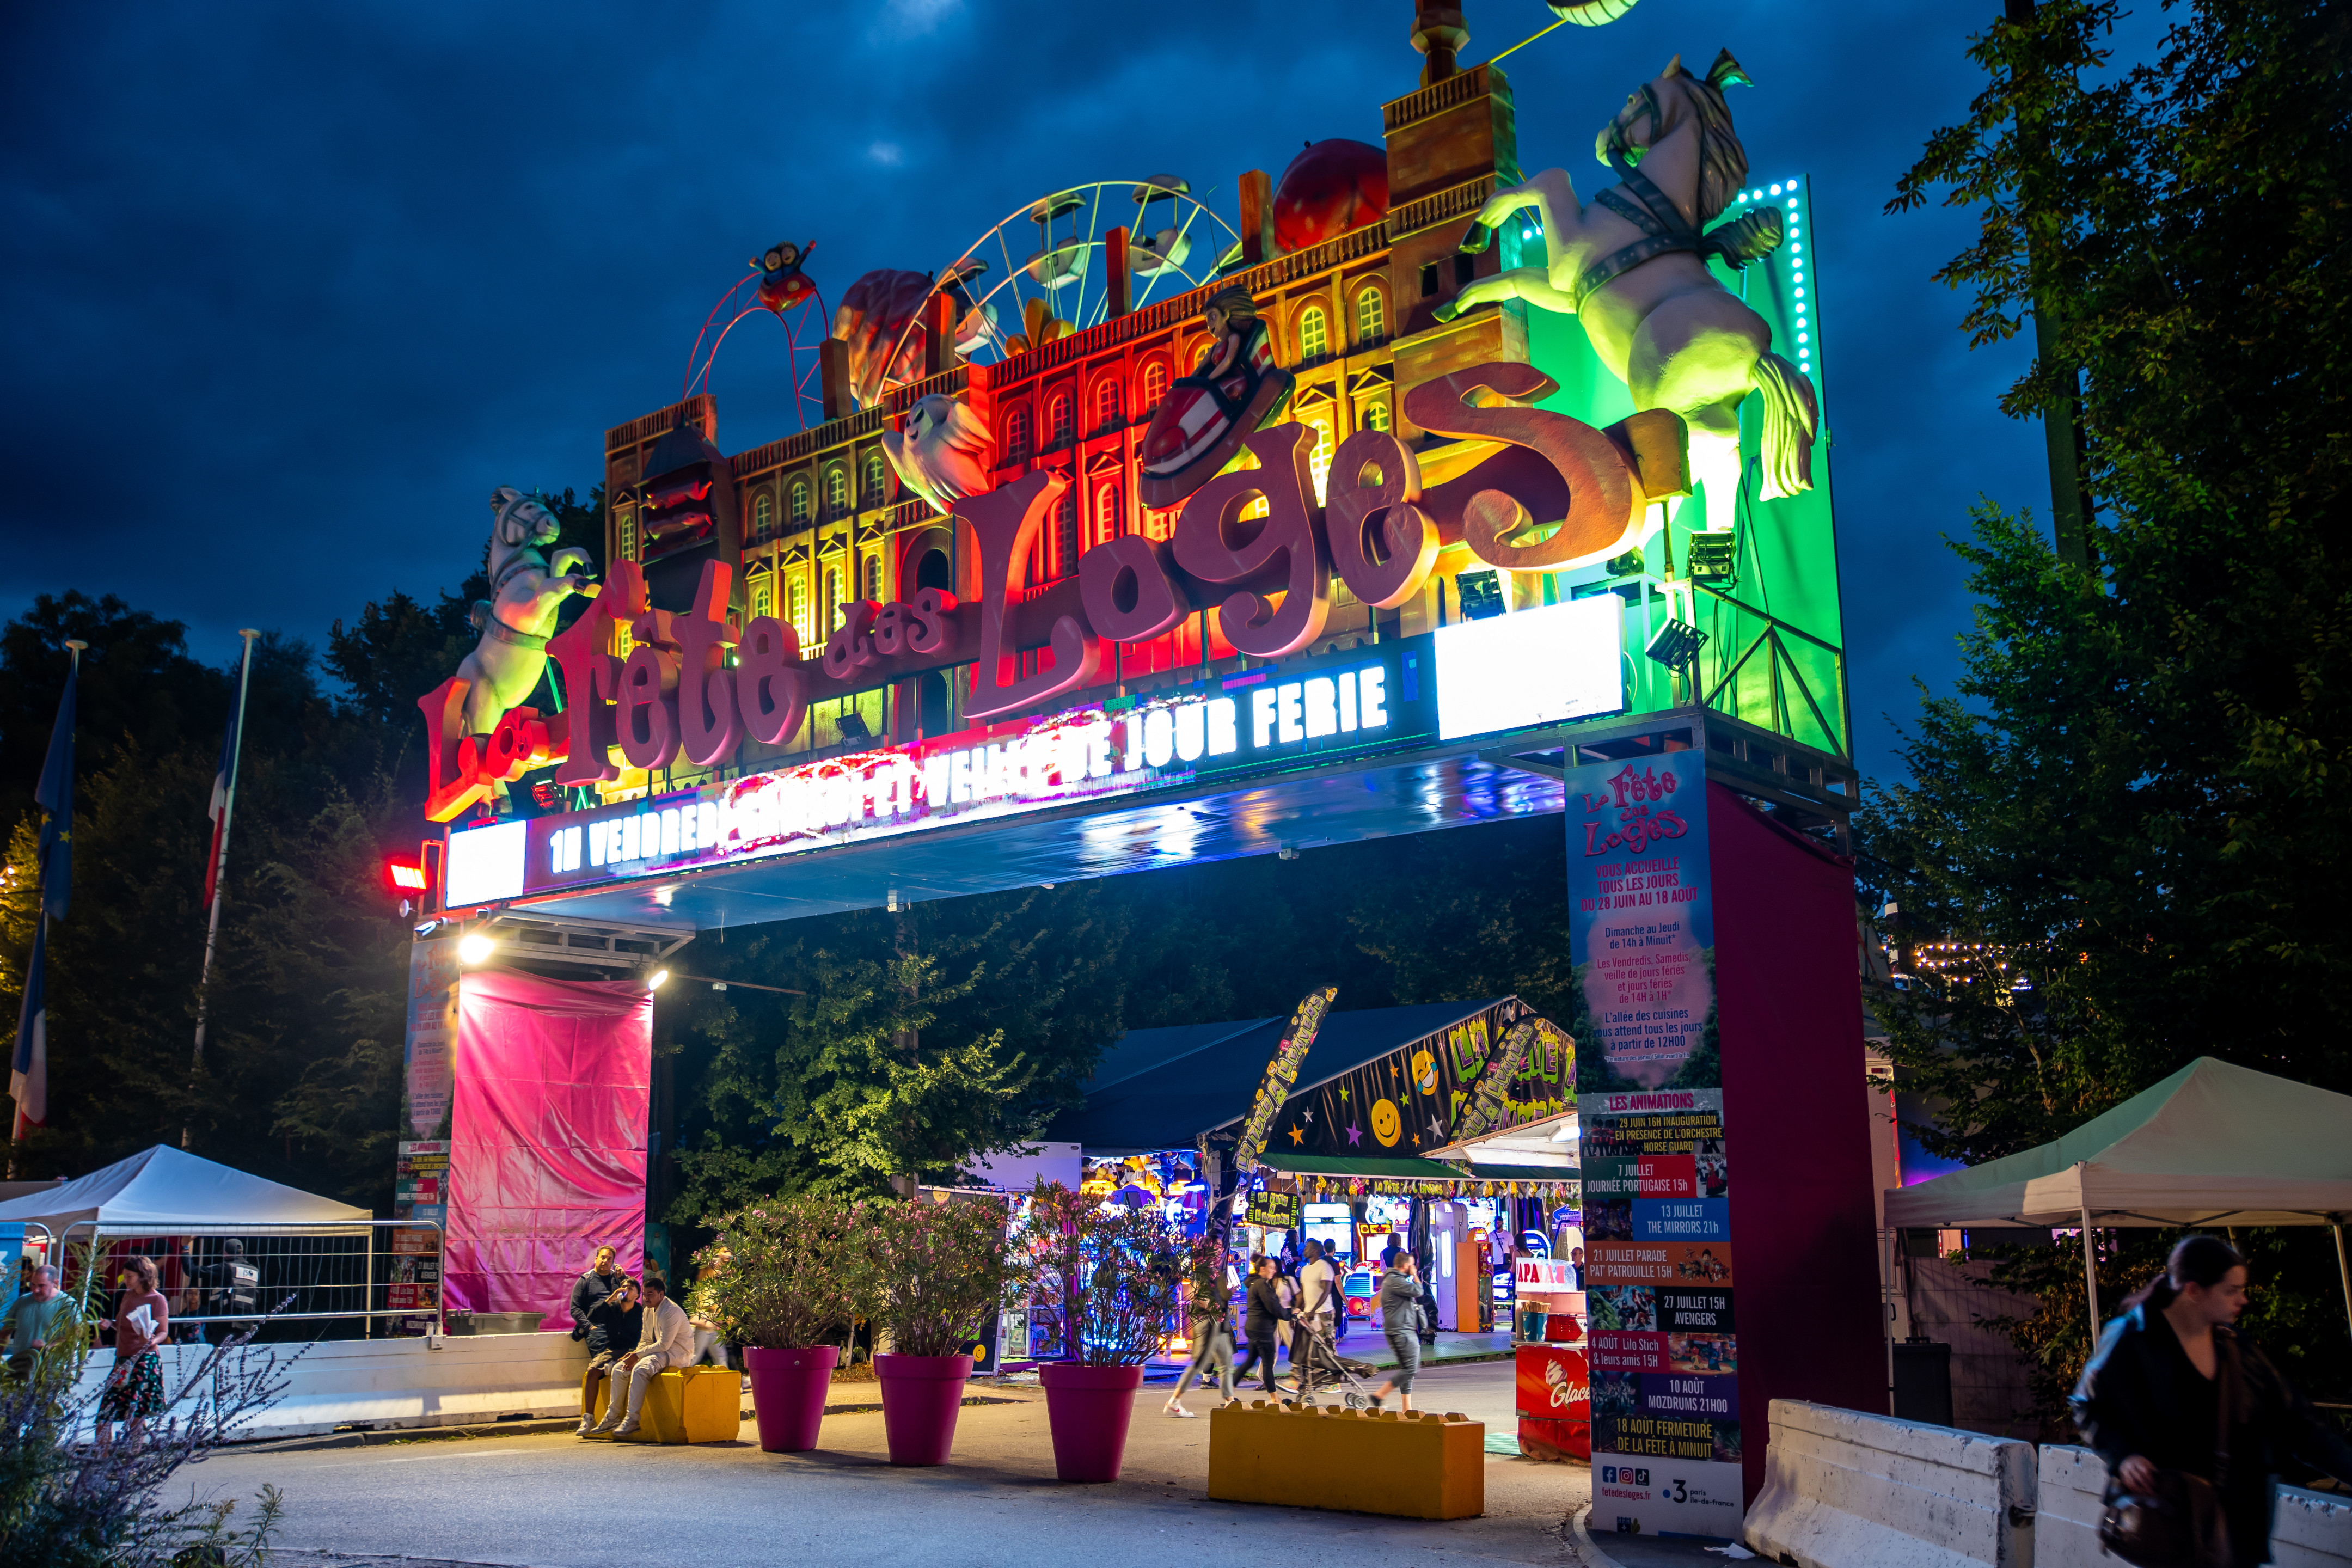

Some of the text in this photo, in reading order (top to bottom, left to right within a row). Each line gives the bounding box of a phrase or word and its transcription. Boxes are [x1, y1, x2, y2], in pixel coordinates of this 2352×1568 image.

[418, 676, 549, 821] La
[546, 558, 807, 786] Fête
[823, 587, 957, 679] des
[953, 361, 1645, 718] Loges
[1124, 697, 1236, 771] JOUR
[1253, 666, 1388, 748] FERIE
[1582, 764, 1677, 813] La Fête
[1620, 805, 1649, 822] des
[1583, 810, 1688, 857] Loges
[1596, 857, 1680, 878] VOUS ACCUEILLE
[1597, 873, 1679, 895] TOUS LES JOURS
[1581, 884, 1698, 911] DU 28 JUIN AU 18 AOÛT
[1606, 921, 1680, 938] Dimanche au Jeudi
[1610, 940, 1619, 949] de
[1622, 938, 1636, 947] 14h
[1639, 936, 1643, 947] à
[1597, 959, 1610, 969] Les
[1604, 964, 1685, 980] veille de jours fériés
[1618, 978, 1673, 993] et jours fériés
[1620, 994, 1628, 1003] de
[1632, 992, 1646, 1002] 14H
[1649, 991, 1654, 1002] à
[1605, 1008, 1688, 1024] L'allée des cuisines
[1594, 1021, 1702, 1038] vous attend tous les jours
[1449, 1020, 1490, 1084] LA
[1610, 1036, 1686, 1052] à partir de 12H00
[1236, 1141, 1254, 1173] LA
[1287, 994, 1325, 1065] ENVERS
[1459, 1110, 1486, 1141] ETE
[1494, 1023, 1533, 1085] ENVERS
[1609, 1093, 1694, 1111] LES ANIMATIONS
[1619, 1116, 1716, 1128] 29 JUIN 16H INAUGURATION
[1615, 1128, 1722, 1140] EN PRÉSENCE DE L'ORCHESTRE
[1644, 1141, 1693, 1152] HORSE GUARD
[1618, 1165, 1653, 1177] 7 JUILLET
[1587, 1177, 1688, 1192] JOURNÉE PORTUGAISE 15h
[1258, 1192, 1268, 1203] LA
[1661, 1205, 1702, 1217] 13 JUILLET
[1647, 1221, 1719, 1234] THE MIRRORS 21h
[1594, 1250, 1667, 1262] 21 JUILLET PARADE
[1590, 1265, 1672, 1278] PAT' PATROUILLE 15H
[1664, 1296, 1725, 1309] 27 JUILLET 15H
[1675, 1313, 1716, 1326] AVENGERS
[1591, 1334, 1659, 1351] 4 AOÛT Lilo Stich
[1594, 1352, 1658, 1367] & leurs amis 15H
[1670, 1377, 1704, 1394] 10 AOÛT
[1649, 1395, 1727, 1412] MOZDRUMS 21H00
[1617, 1416, 1713, 1439] 18 AOÛT FERMETURE
[1618, 1435, 1712, 1458] DE LA FÊTE À MINUIT
[1602, 1487, 1651, 1501] fetedesloges.fr
[1673, 1479, 1687, 1504] 3
[1690, 1498, 1734, 1507] île-de-france
